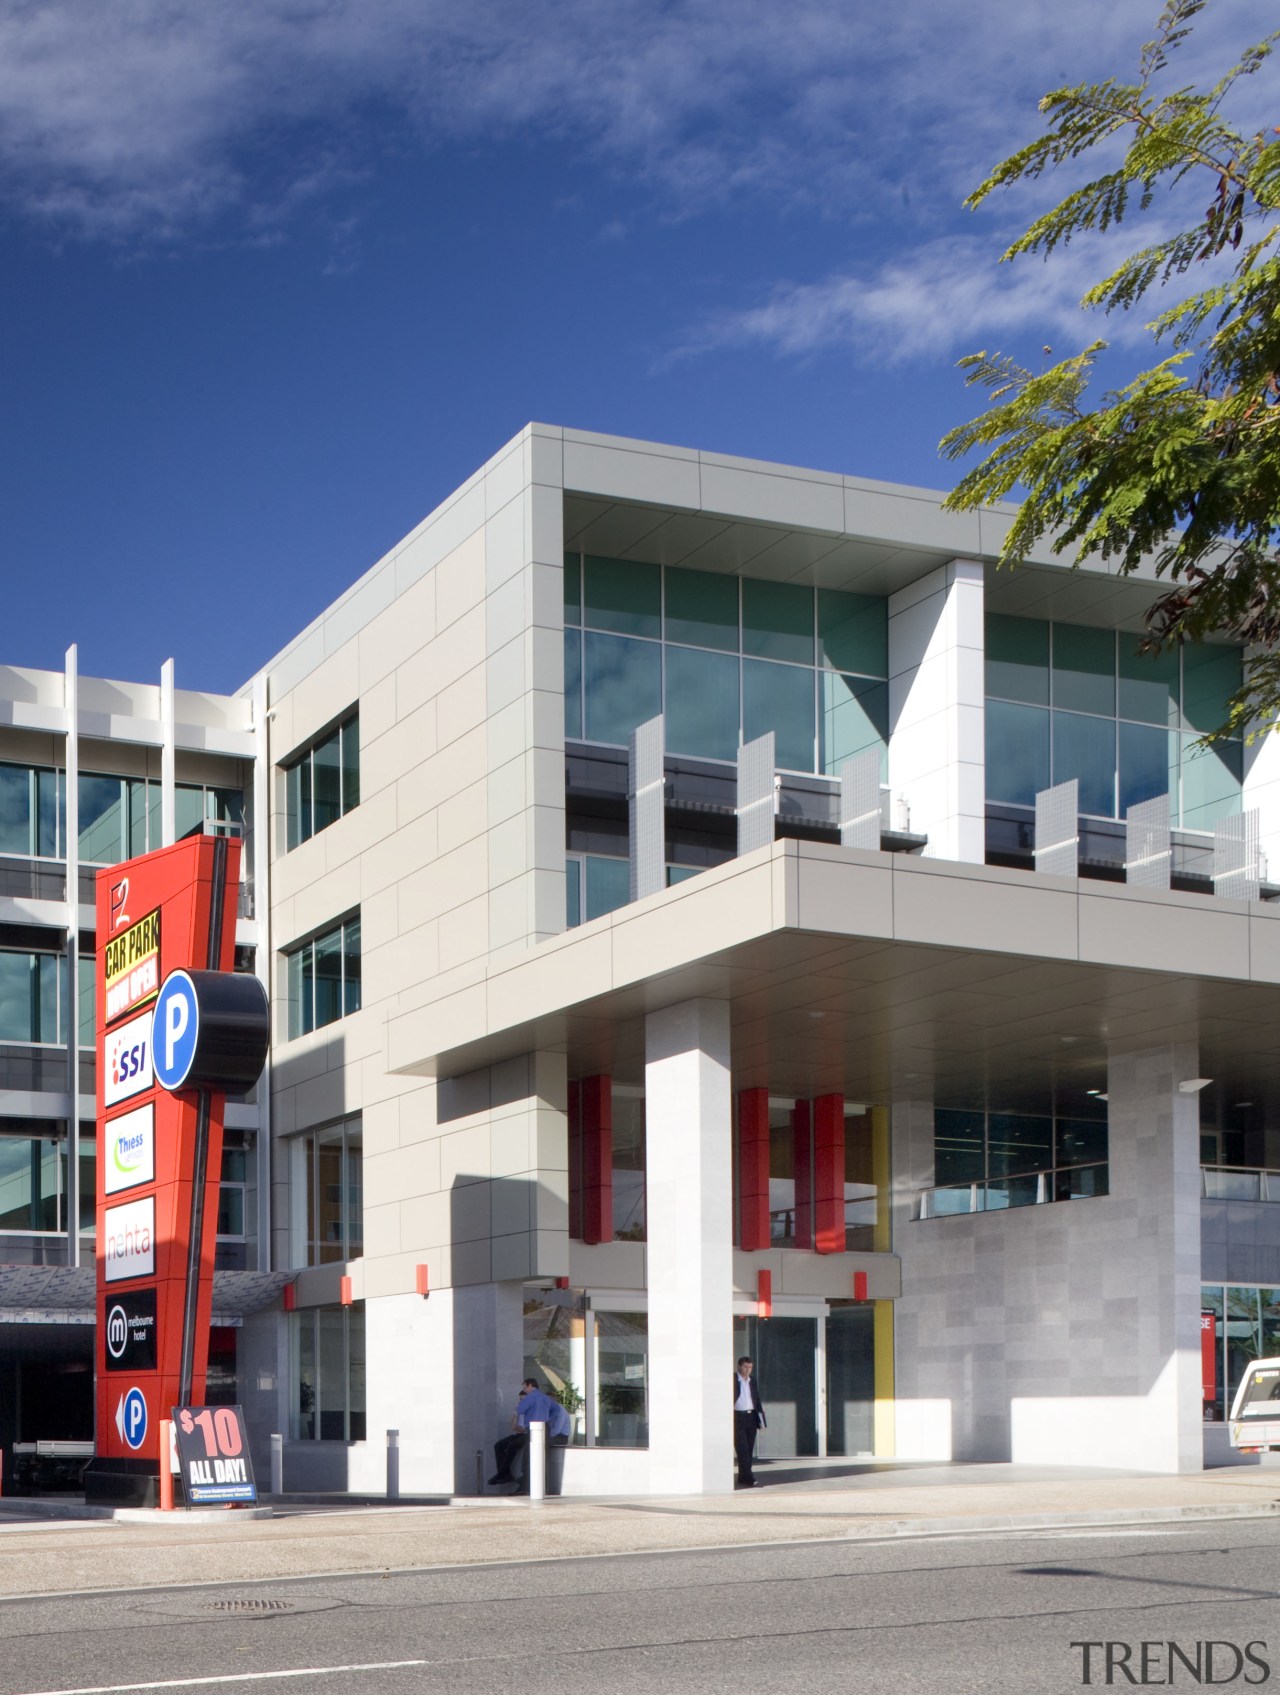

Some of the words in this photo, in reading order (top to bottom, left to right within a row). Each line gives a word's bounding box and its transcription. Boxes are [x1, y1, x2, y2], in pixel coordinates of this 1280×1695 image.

[106, 936, 126, 979] CAR
[129, 910, 159, 964] PARK
[107, 976, 129, 1018] NOW
[130, 957, 156, 1000] OPEN
[166, 993, 189, 1071] P
[118, 1133, 143, 1154] Thiess
[108, 1224, 151, 1260] nehta
[111, 1318, 124, 1342] m
[128, 1315, 153, 1327] melbourne
[133, 1329, 146, 1341] hotel
[130, 1399, 142, 1438] P
[180, 1408, 243, 1457] $10
[189, 1461, 214, 1484] ALL
[214, 1458, 247, 1483] DAY!
